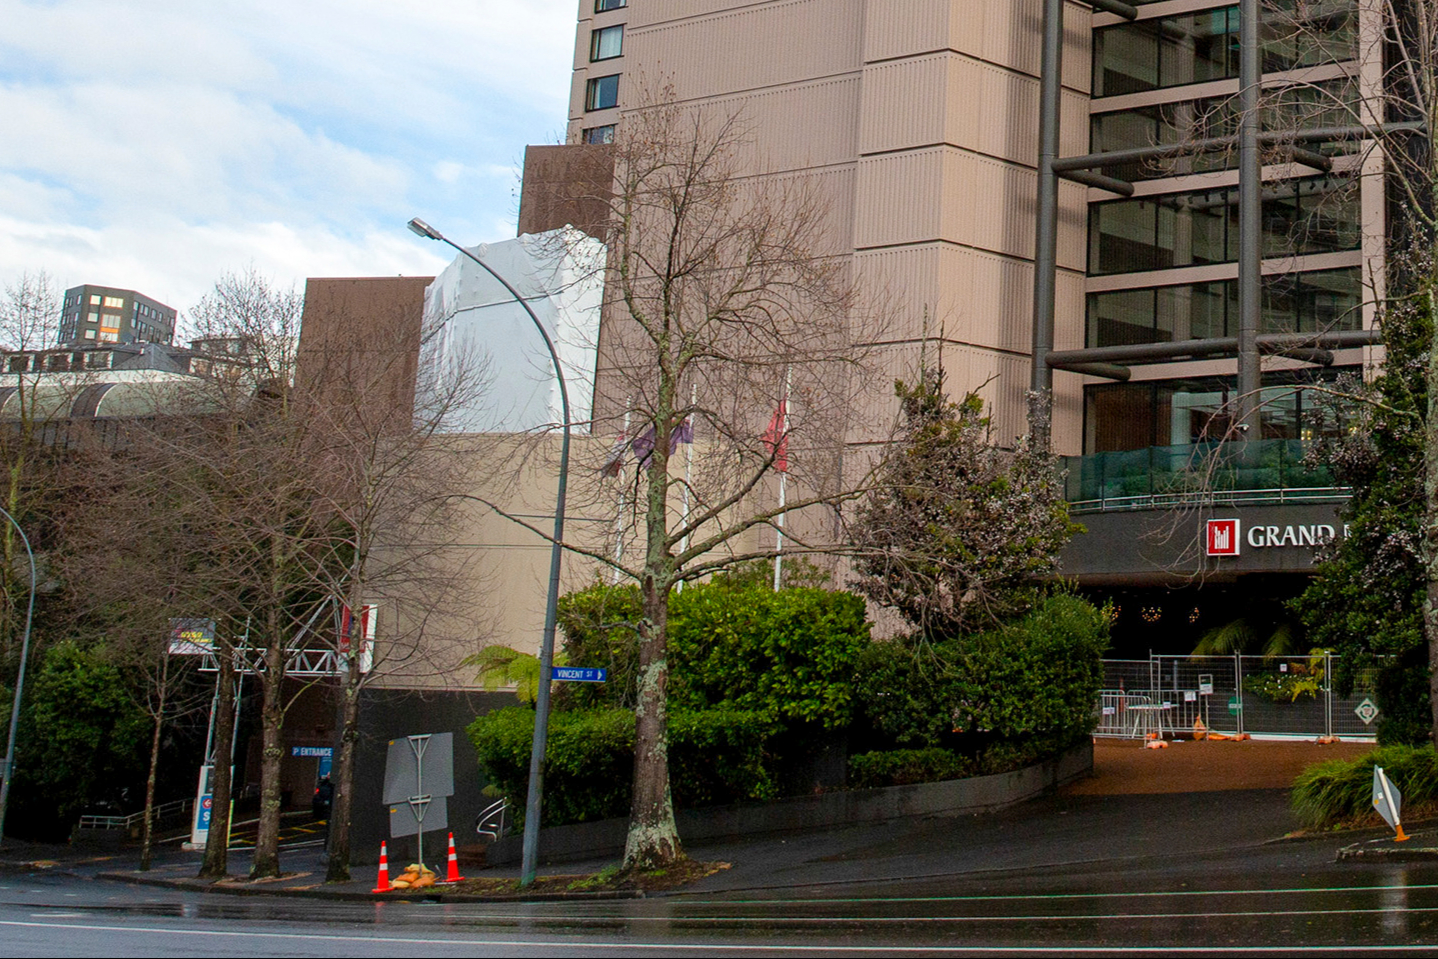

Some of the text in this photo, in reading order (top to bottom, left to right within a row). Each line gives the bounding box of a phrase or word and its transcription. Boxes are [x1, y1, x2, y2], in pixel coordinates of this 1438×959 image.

[1247, 524, 1336, 547] GRAND
[557, 669, 584, 679] VINCENT
[300, 747, 332, 756] ENTRANCE
